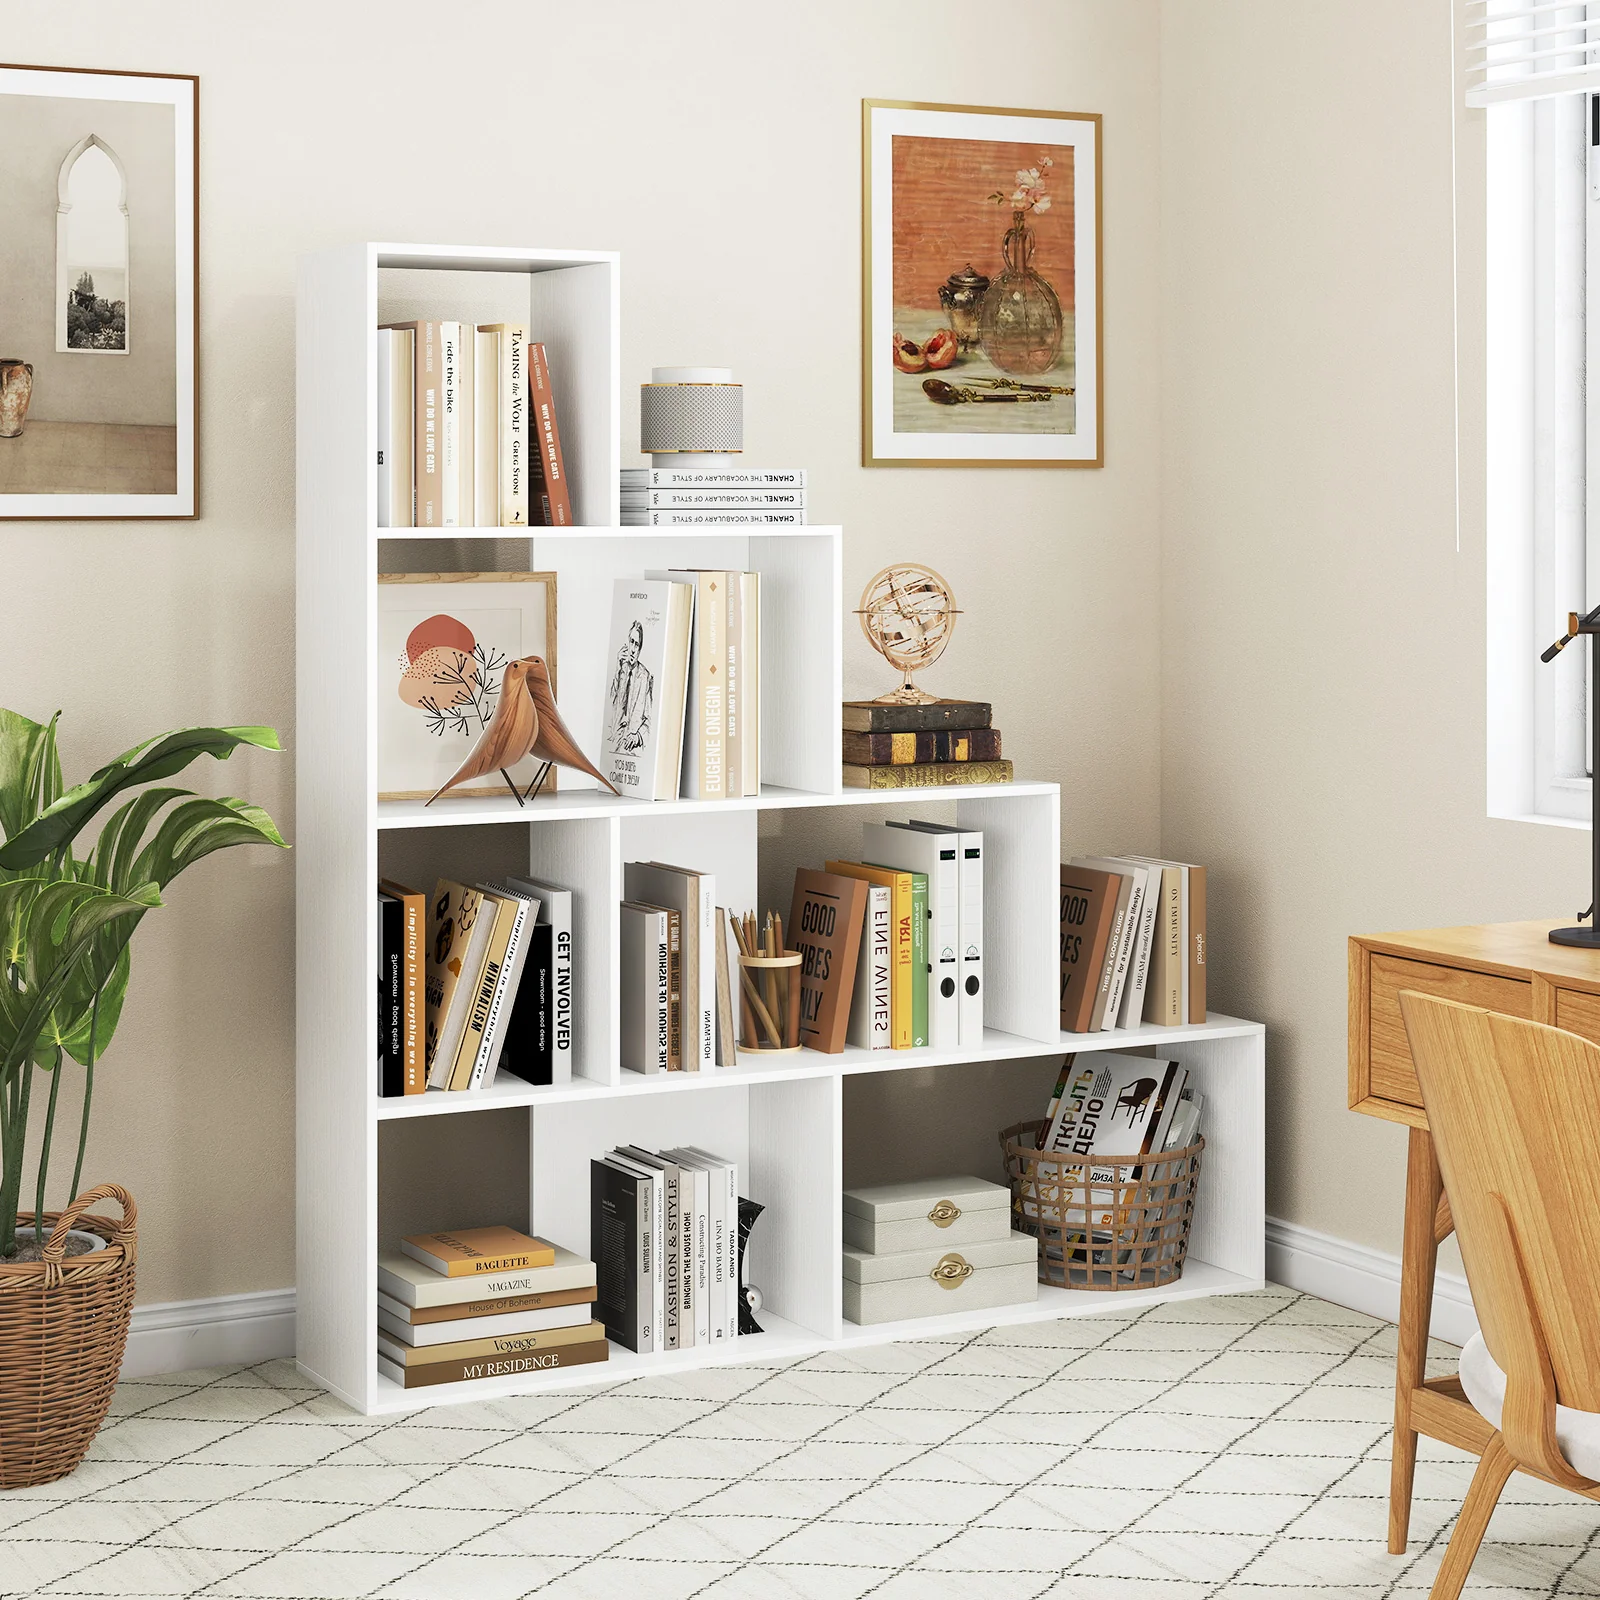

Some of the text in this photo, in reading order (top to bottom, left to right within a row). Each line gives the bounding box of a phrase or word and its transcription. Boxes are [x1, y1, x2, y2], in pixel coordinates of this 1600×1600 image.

[446, 341, 454, 414] ride the bike
[512, 330, 522, 433] TAMING the WOLF
[426, 389, 435, 474] WHY DO WE LOVE CATS
[541, 404, 560, 480] WHY DO WE LOVE CATS
[512, 440, 521, 496] GREG STONE
[728, 645, 736, 737] WHY DO WE LOVE CATS
[706, 686, 721, 792] EUGENE ONEGIN
[1060, 894, 1088, 926] OOD
[1171, 888, 1178, 902] ON
[407, 907, 418, 960] simplicity
[801, 900, 836, 938] GOOD
[1114, 910, 1124, 934] GUIDE
[1122, 915, 1136, 956] sustainable
[1130, 887, 1142, 915] lifestyle
[1144, 907, 1154, 936] AWAKE
[1109, 934, 1120, 958] GOOD
[1142, 935, 1150, 952] world
[1195, 934, 1204, 964] spherical
[409, 963, 417, 973] is
[409, 976, 417, 987] in
[1102, 974, 1110, 992] THIS
[1106, 966, 1112, 974] IS
[1136, 961, 1146, 990] DREAM
[470, 961, 500, 1033] MINIMALISM
[476, 911, 524, 1080] simplicity is in everything we see
[558, 931, 570, 1050] GET INVOLVED
[801, 986, 824, 1022] NLY
[407, 990, 417, 1047] everything
[538, 1010, 546, 1028] good
[538, 1029, 546, 1052] design
[409, 1050, 416, 1064] we
[1053, 1069, 1094, 1154] ТКРЫТЬ
[1072, 1098, 1104, 1155] ДЕЛО
[1090, 1172, 1126, 1184] ДИЗАН
[698, 1214, 706, 1258] Constructing
[716, 1242, 722, 1255] BO
[475, 1256, 529, 1272] BAGUETTE
[668, 1179, 677, 1328] FASHION & STYLE
[487, 1278, 532, 1292] MAGAZINE
[468, 1296, 542, 1313] House Of Boheme
[494, 1336, 537, 1352] Voyage
[463, 1354, 560, 1379] MY RESIDENCE
